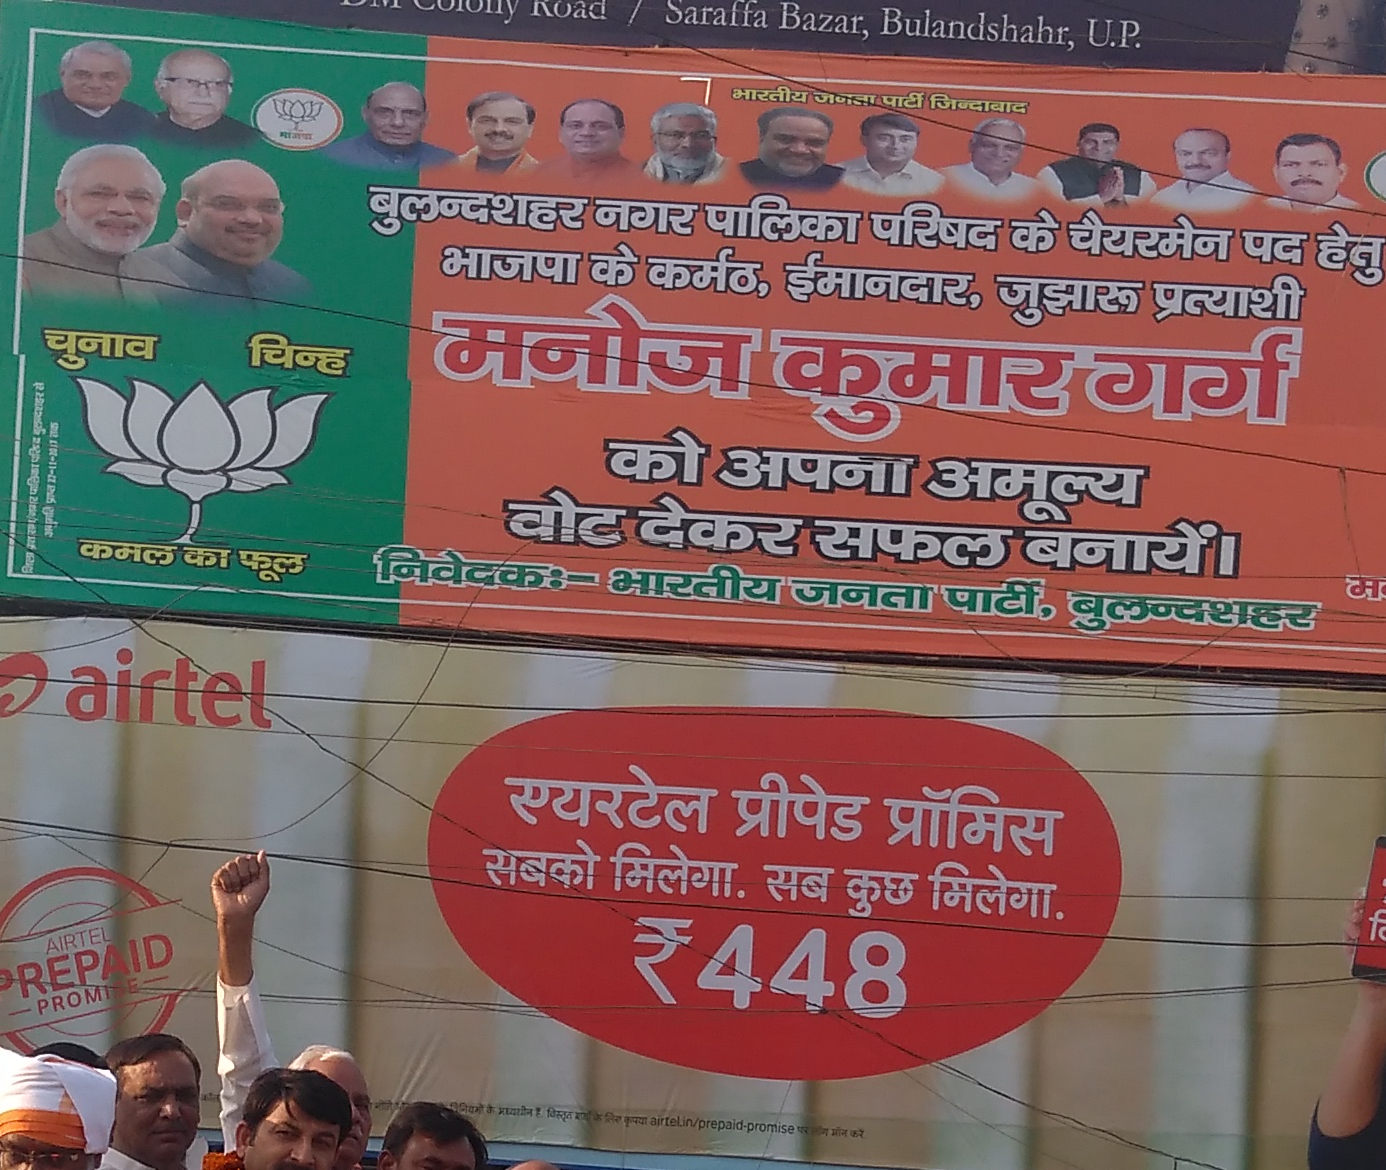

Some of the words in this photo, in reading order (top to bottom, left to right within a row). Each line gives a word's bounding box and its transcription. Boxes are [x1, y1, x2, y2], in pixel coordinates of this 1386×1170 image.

[531, 0, 607, 20] Road
[665, 0, 769, 29] Saraffa
[779, 1, 869, 41] Bazar,
[880, 7, 1075, 52] Bulandshahr,
[1087, 18, 1142, 49] U.P.
[732, 78, 808, 104] भारतीय
[813, 89, 876, 107] जनता
[882, 88, 924, 110] पार्टी
[368, 185, 589, 236] बुलन्दशहर
[592, 197, 698, 235] नगर
[704, 193, 860, 244] पालिका
[870, 201, 1004, 252] परिषद
[1011, 210, 1062, 254] के
[1242, 228, 1309, 267] पद
[442, 244, 580, 285] भाजपा
[589, 243, 639, 287] के
[647, 248, 770, 299] कर्मठ,
[783, 252, 982, 311] ईमानदार,
[995, 271, 1143, 327] जुझारू
[1153, 274, 1306, 322] प्रत्याशी
[41, 327, 162, 371] चुनाव
[247, 332, 354, 377] चिन्ह
[432, 294, 763, 400] मनोज
[769, 329, 1075, 443] कुमार
[1082, 326, 1303, 426] गर्ग
[603, 426, 711, 487] को
[714, 446, 920, 497] अपना
[921, 457, 1150, 524] अमूल्य
[78, 538, 177, 567] कमल
[181, 544, 234, 569] का
[237, 549, 310, 582] फूल
[503, 485, 627, 548] वोट
[632, 492, 803, 557] देकर
[813, 517, 1014, 570] सफल
[608, 564, 785, 605] भारतीय
[790, 577, 938, 614] जनता
[943, 578, 1056, 621] पार्टी,
[1065, 590, 1322, 634] बुलन्दशहर
[65, 647, 272, 729] airtel
[504, 765, 718, 834] एयरटेल
[731, 772, 870, 842] प्रीपेड
[884, 785, 1065, 857] प्रॉमिस
[481, 839, 600, 891] सबको
[611, 841, 746, 900] मिलेगा.
[764, 861, 834, 903] सब
[845, 867, 918, 917] कुछ
[927, 860, 1066, 921] मिलेगा.
[45, 926, 112, 955] AIRTEL
[37, 976, 139, 1016] PROMISE
[650, 1116, 795, 1136] airtel.in/prepaid-promise
